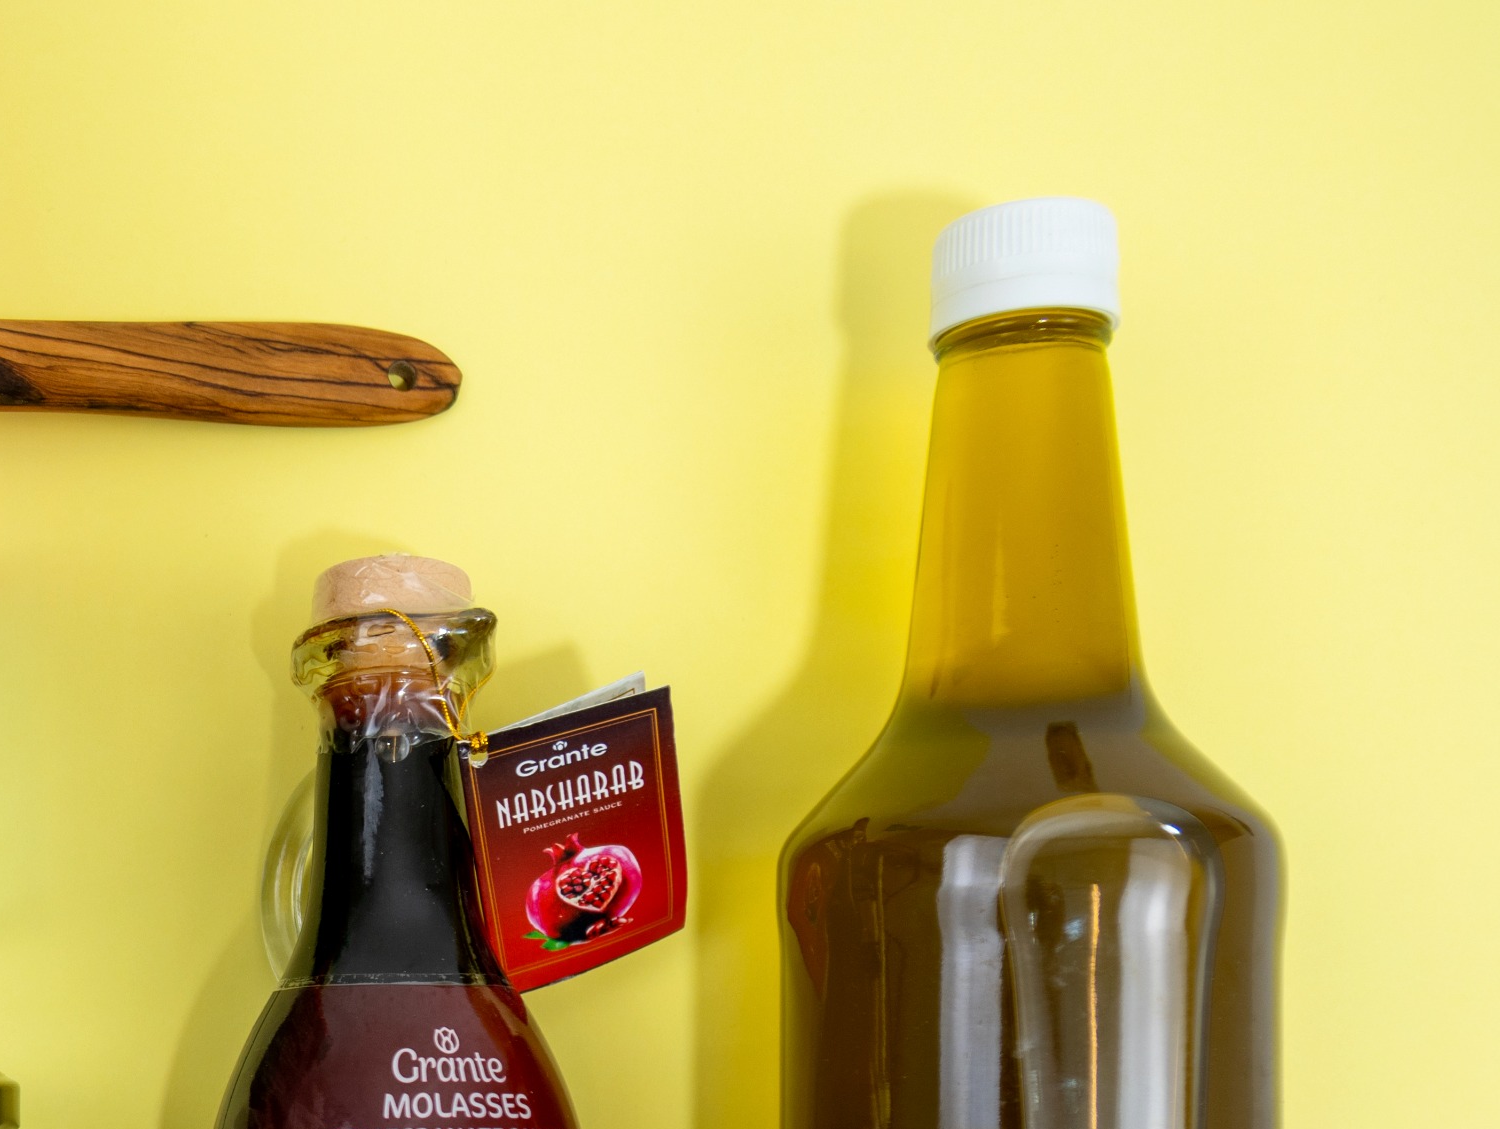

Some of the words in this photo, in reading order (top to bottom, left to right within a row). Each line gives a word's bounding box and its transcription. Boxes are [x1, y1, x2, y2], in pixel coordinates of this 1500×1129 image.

[515, 741, 607, 777] Grante
[496, 760, 645, 829] NARSHARAB
[523, 810, 590, 834] POMEGRANATE
[593, 801, 622, 815] SAUCE
[392, 1048, 506, 1083] Grante
[383, 1093, 531, 1119] MOLASSES
